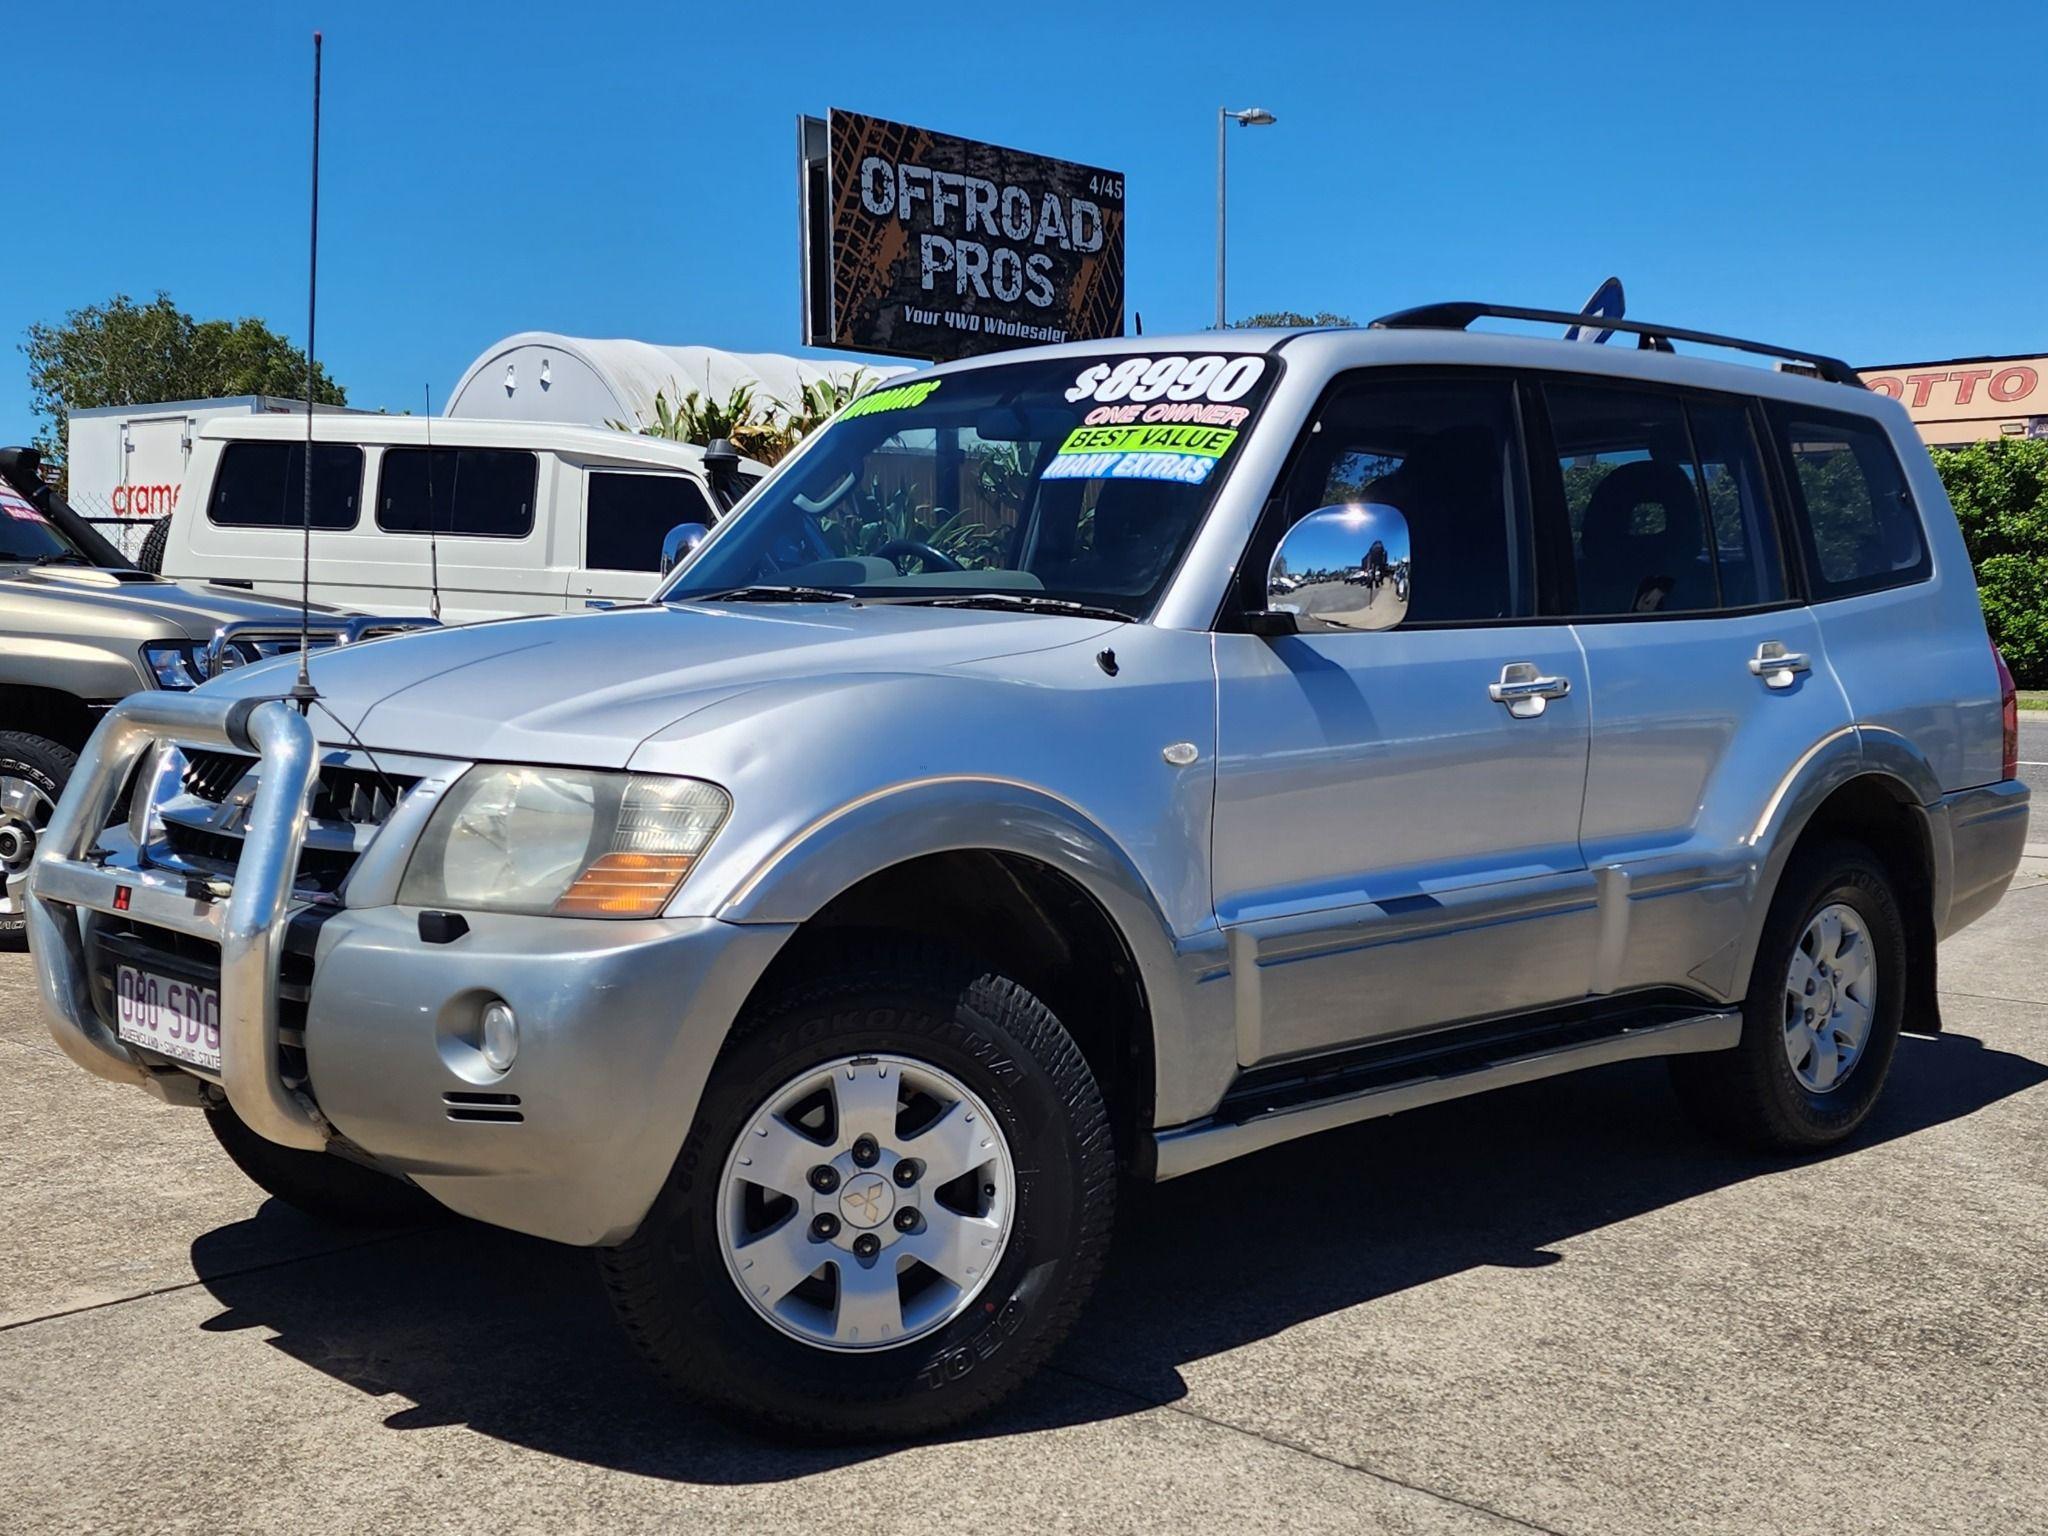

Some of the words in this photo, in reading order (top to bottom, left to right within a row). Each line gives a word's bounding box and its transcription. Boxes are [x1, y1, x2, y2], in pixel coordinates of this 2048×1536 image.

[1089, 175, 1123, 200] 4/45
[861, 157, 1104, 253] OFFROAD
[921, 233, 1056, 308] PROS
[904, 305, 941, 327] Your
[944, 312, 980, 332] 4WD
[984, 316, 1069, 342] Wholesaler
[1064, 355, 1266, 403] $8990
[1084, 405, 1147, 426] ONE
[1142, 404, 1250, 427] OWNER
[1069, 429, 1139, 448] BEST
[1140, 429, 1231, 451] VALUE
[1042, 454, 1124, 479] MANY
[1111, 453, 1216, 484] EXTRAS
[0, 758, 56, 790] OPER
